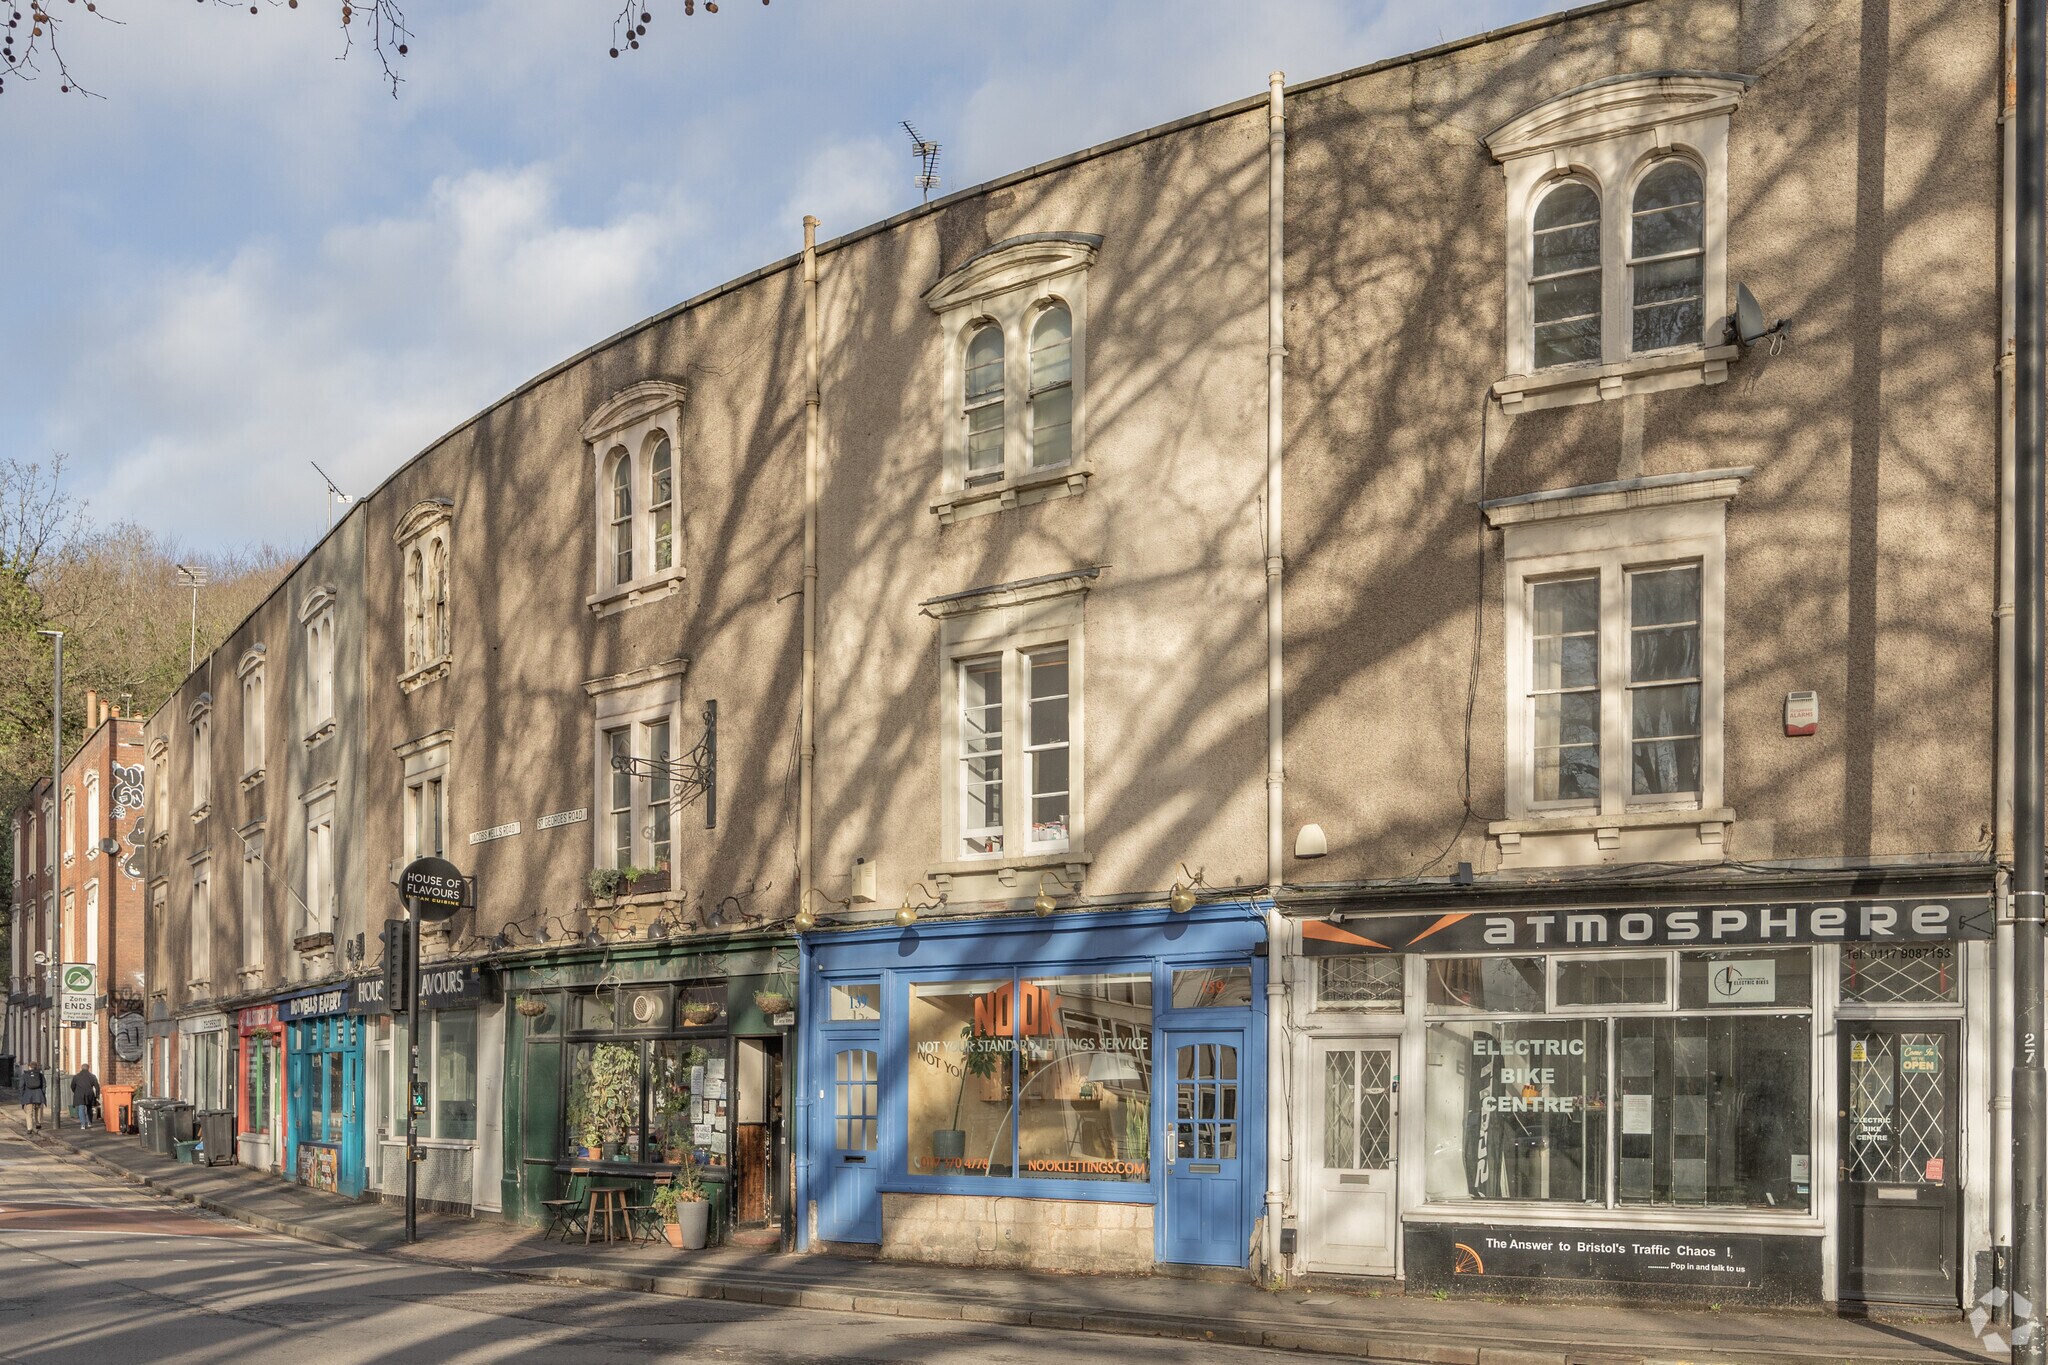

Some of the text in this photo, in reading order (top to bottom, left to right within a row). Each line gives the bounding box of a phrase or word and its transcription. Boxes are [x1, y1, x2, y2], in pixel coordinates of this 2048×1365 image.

[568, 809, 583, 823] ROAD
[471, 824, 516, 843] JACOBS WELLS ROAD
[407, 872, 462, 888] HOUSE OF
[406, 883, 460, 899] FLAVOURS
[1870, 948, 1897, 960] 0117
[1900, 947, 1951, 960] 9087153
[358, 979, 385, 1003] HOUS
[64, 1002, 92, 1010] ENDS
[850, 994, 867, 1009] 139
[974, 980, 1064, 1037] NOOK
[917, 1037, 1149, 1053] NOT YOUR STANDARD LETTINGS SERVICE
[1473, 1039, 1584, 1056] ELECTRIC
[1903, 1061, 1934, 1071] OPEN
[1500, 1068, 1555, 1084] BIKE
[1482, 1096, 1574, 1113] CENTRE
[1027, 1159, 1146, 1175] NOOKLETTINGS.COM
[1486, 1238, 1507, 1249] The
[1509, 1239, 1553, 1251] Answer
[1558, 1241, 1571, 1252] to
[1577, 1242, 1626, 1254] Bristol's
[1632, 1243, 1671, 1255] Traffic
[1676, 1245, 1716, 1257] Chaos
[1670, 1262, 1686, 1271] Pop
[1686, 1262, 1694, 1270] in
[1695, 1263, 1710, 1271] and
[1711, 1264, 1725, 1272] talk
